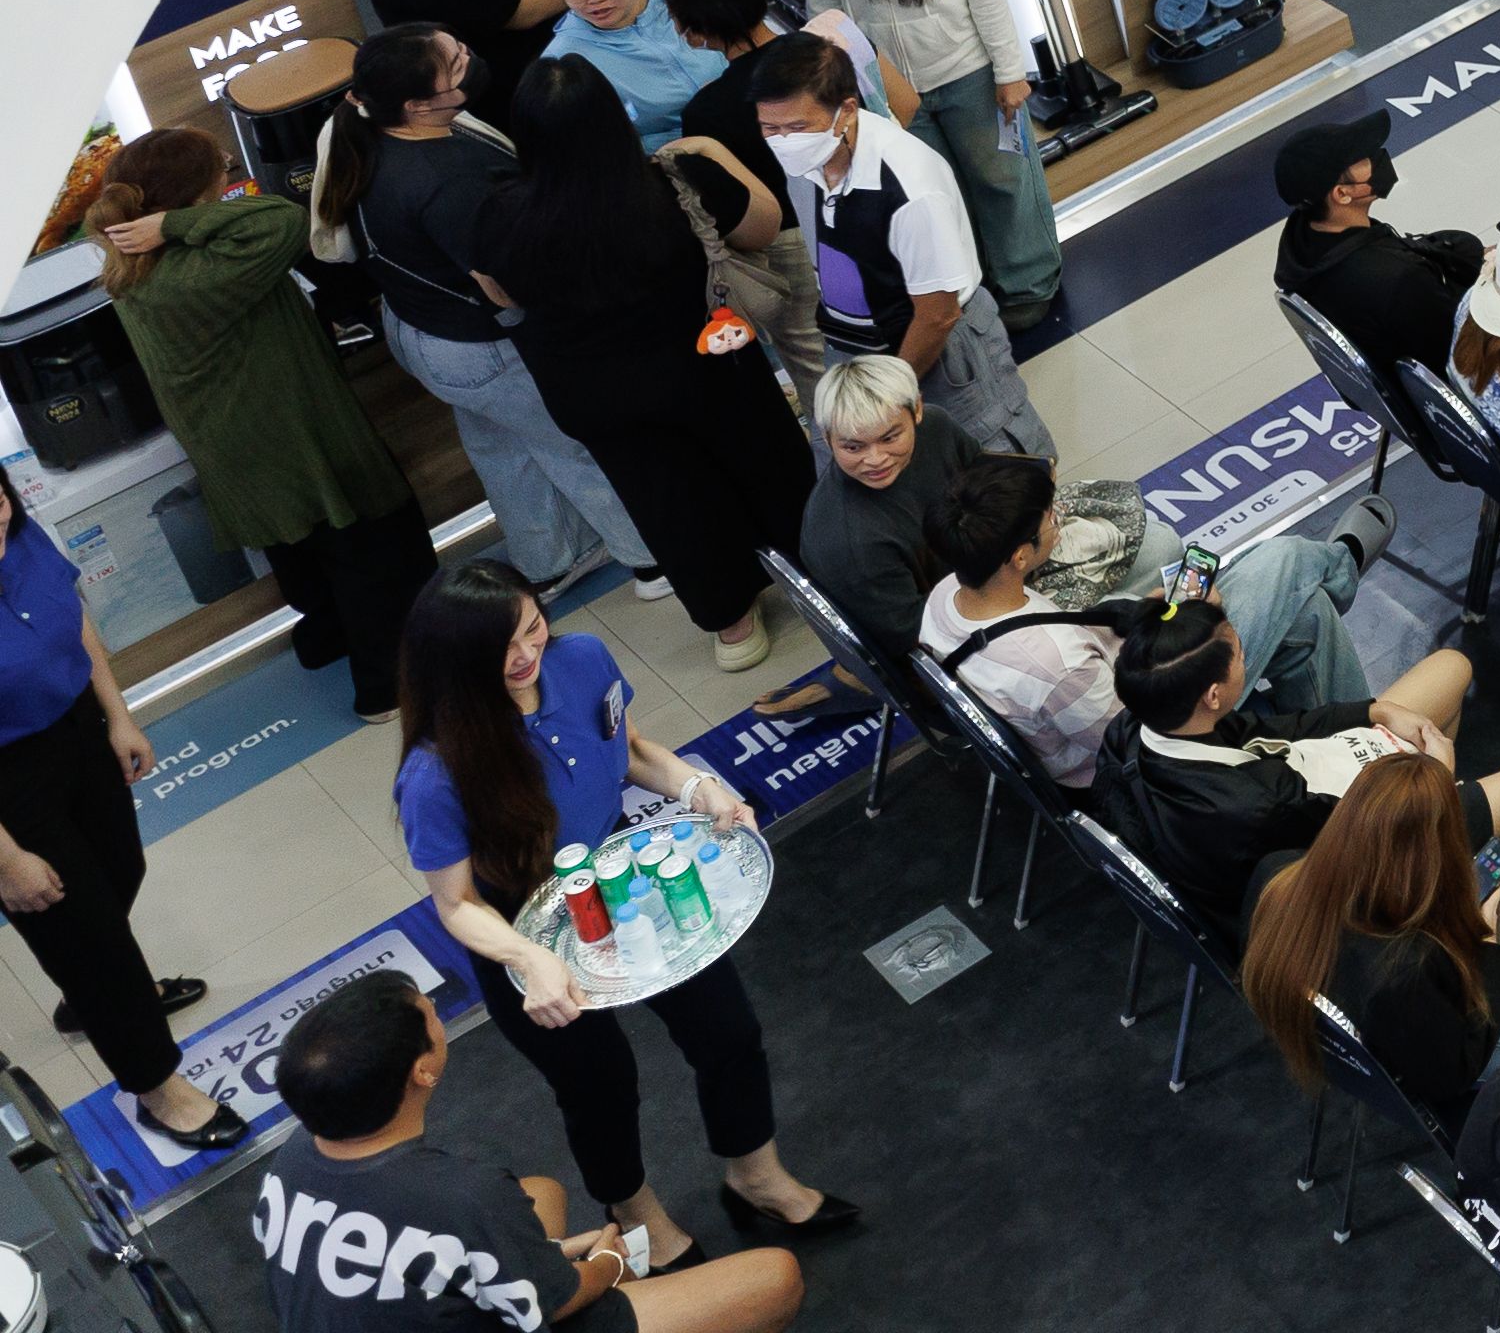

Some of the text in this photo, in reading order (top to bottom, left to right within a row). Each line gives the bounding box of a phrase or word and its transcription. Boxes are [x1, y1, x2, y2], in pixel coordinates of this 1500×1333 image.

[189, 4, 303, 70] MAKE
[153, 718, 300, 800] program.
[221, 1019, 278, 1067] 24
